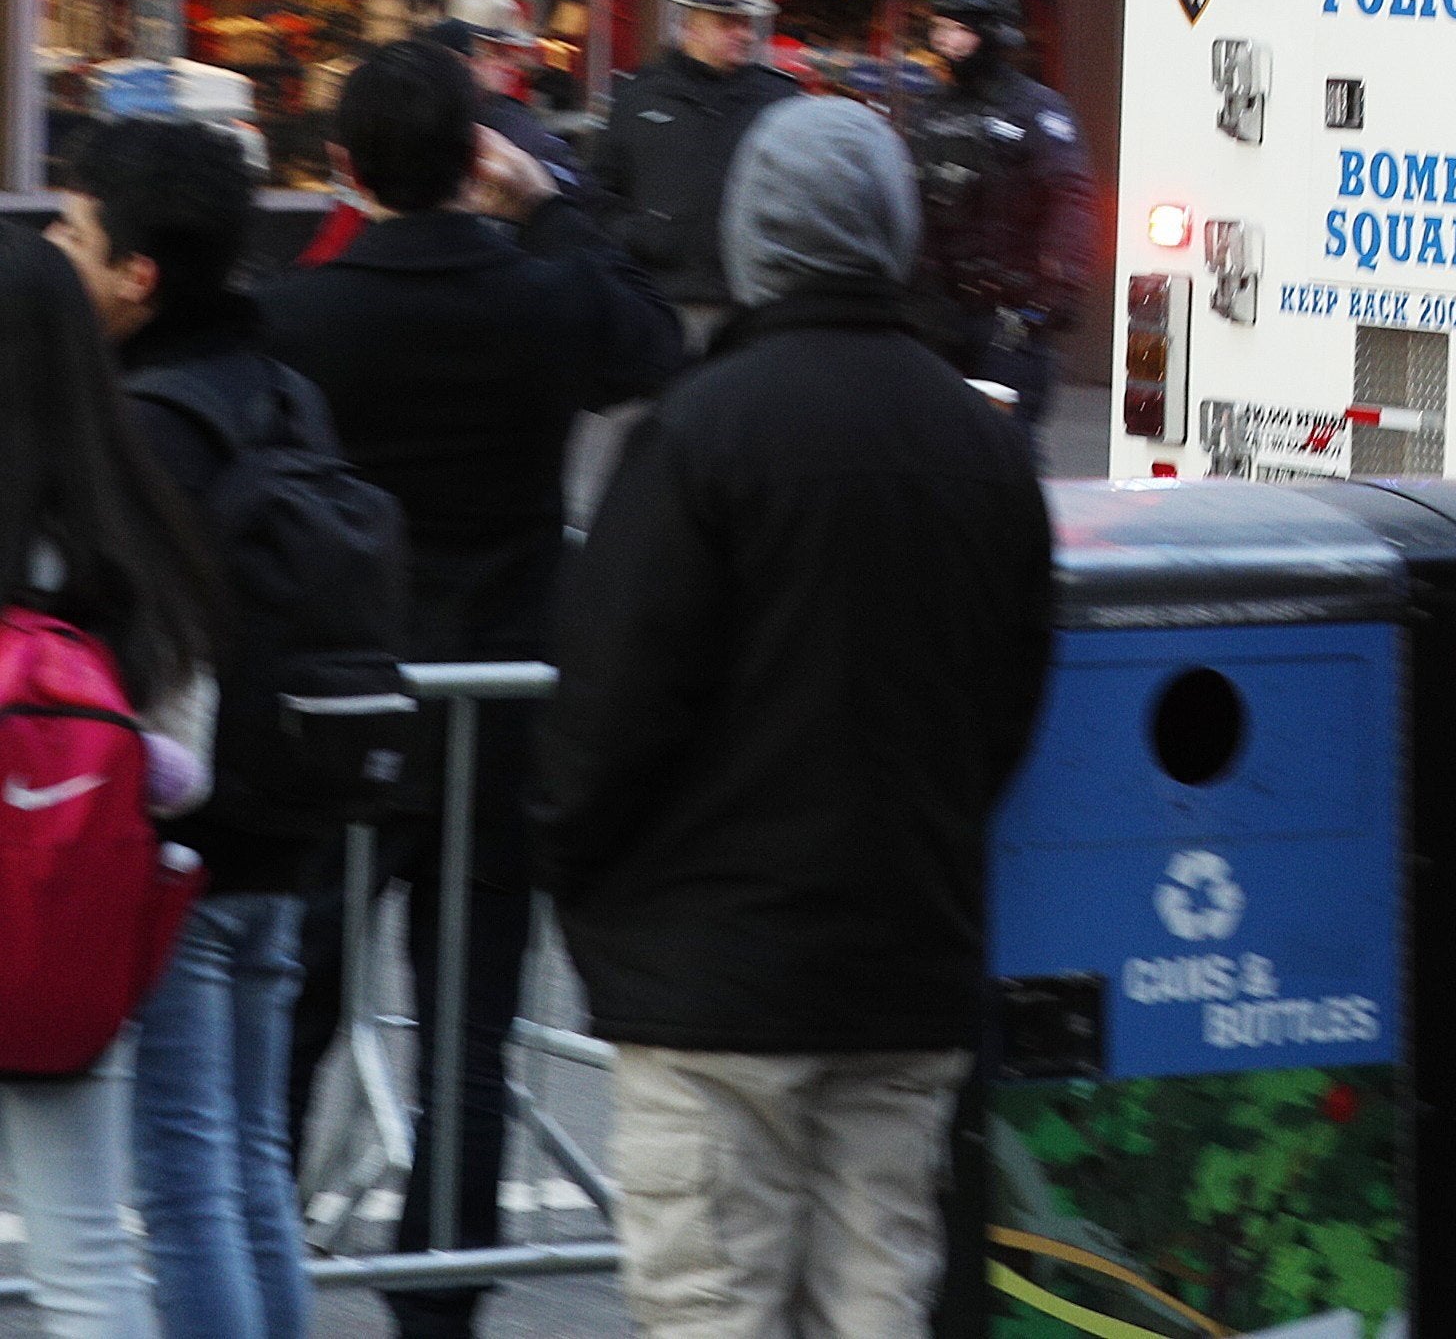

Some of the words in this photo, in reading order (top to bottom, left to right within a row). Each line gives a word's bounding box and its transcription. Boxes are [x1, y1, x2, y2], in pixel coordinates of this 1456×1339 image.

[1280, 284, 1339, 315] KEEP
[1349, 288, 1409, 325] BACK
[1122, 953, 1239, 1005] CANS
[1202, 993, 1381, 1048] BOTTLES
